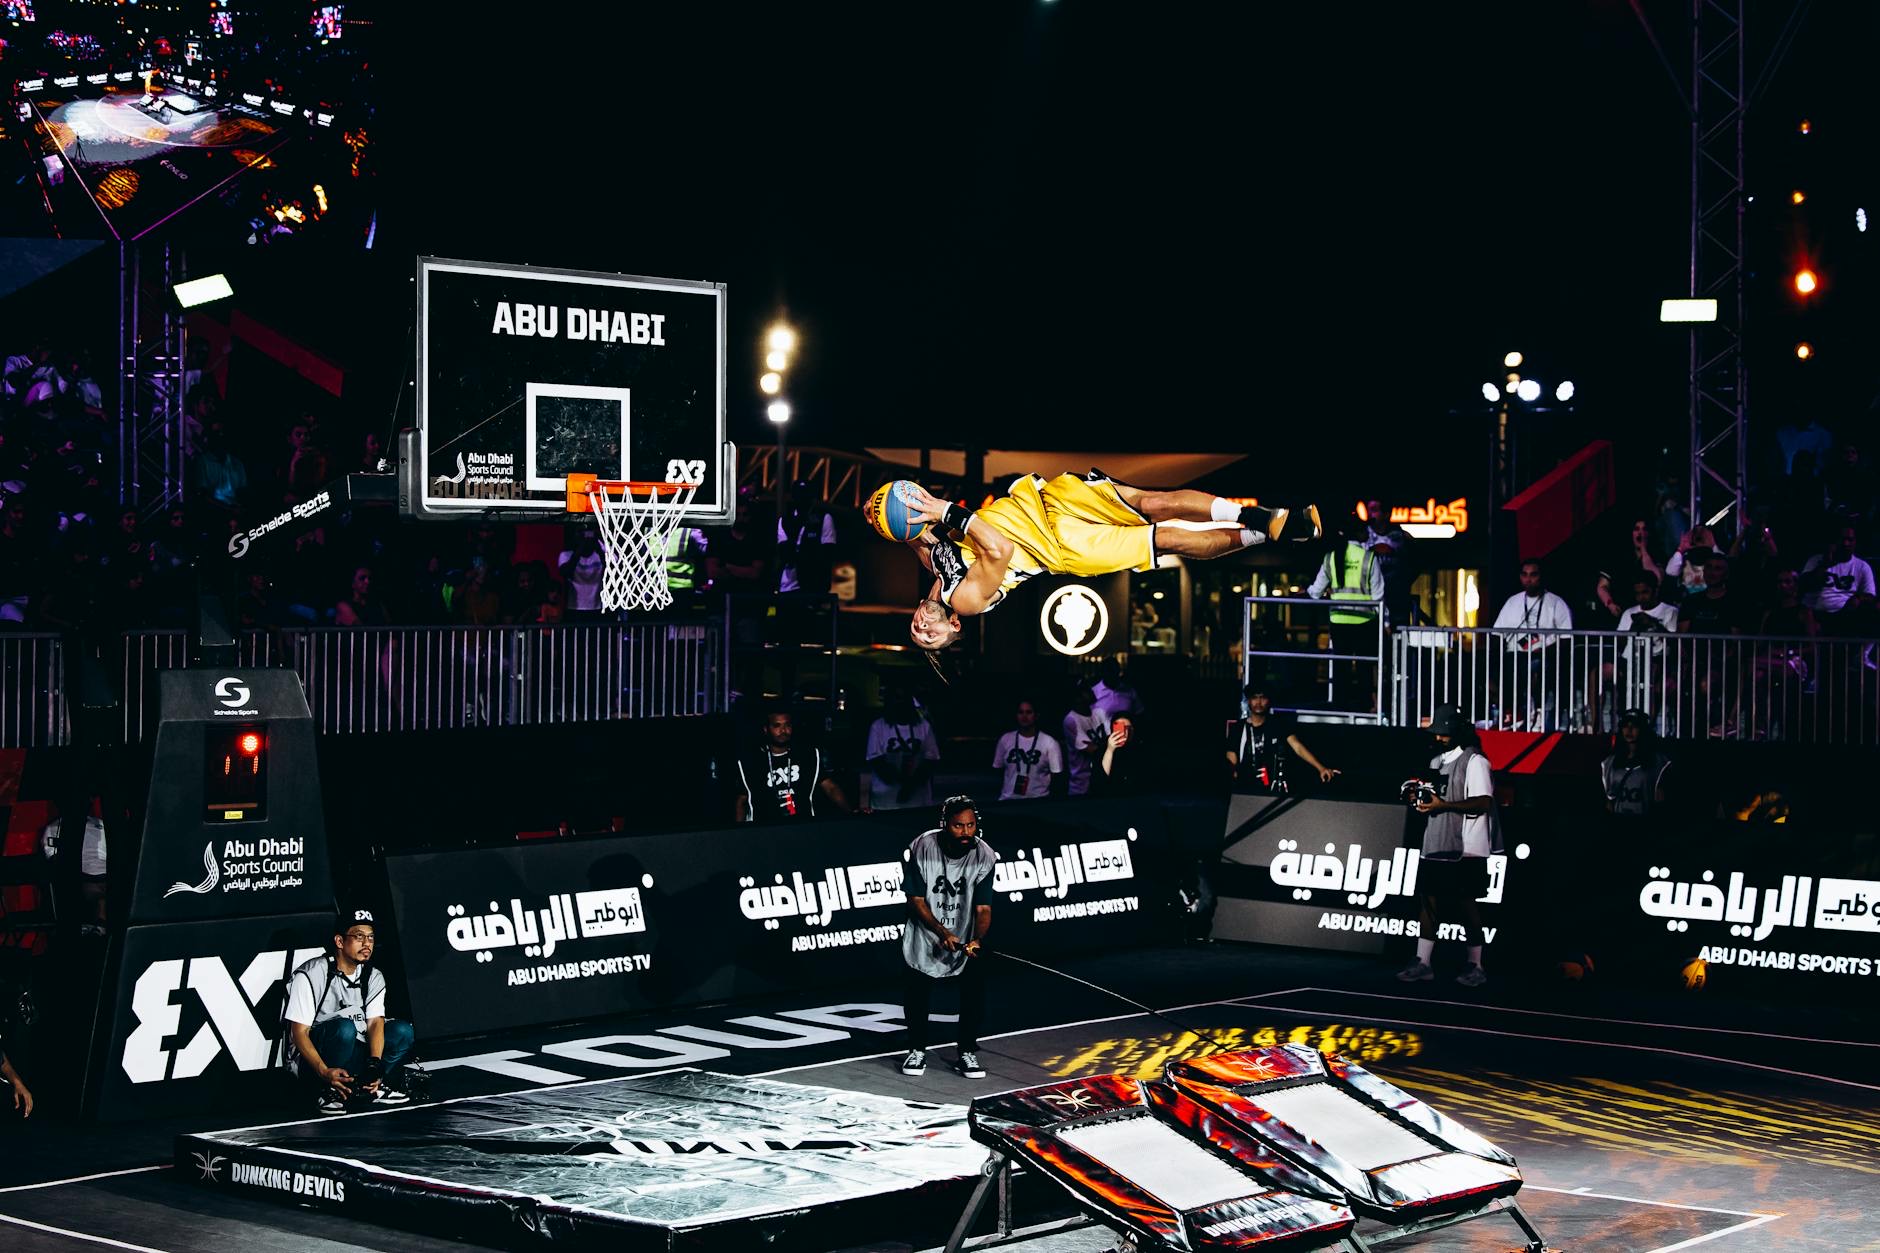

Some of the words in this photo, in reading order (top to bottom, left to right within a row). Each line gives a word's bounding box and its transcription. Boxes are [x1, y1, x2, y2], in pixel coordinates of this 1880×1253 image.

[492, 301, 559, 338] ABU
[566, 307, 666, 346] DHABI
[467, 452, 486, 464] Abu
[487, 453, 514, 465] Dhabi
[467, 464, 489, 475] Sports
[489, 465, 514, 475] Council
[248, 511, 292, 541] Schelde
[292, 491, 330, 517] Sports
[223, 840, 255, 858] Abu
[259, 837, 304, 856] Dhabi
[223, 860, 261, 878] Sports
[262, 857, 304, 873] Council
[280, 876, 303, 887] مجلس
[1270, 839, 1420, 909] الرياضية
[739, 867, 851, 930] الرياضية
[1034, 906, 1055, 922] ABU
[1055, 902, 1087, 919] DHABI
[1086, 897, 1126, 915] SPORTS
[1124, 896, 1139, 911] TV
[1640, 866, 1812, 942] الرياضية
[447, 893, 578, 963] الرياضية
[792, 934, 817, 952] ABU
[816, 930, 853, 949] DHABI
[853, 924, 899, 944] SPORTS
[1318, 912, 1353, 931] ABU
[1353, 916, 1404, 935] DHABI
[507, 966, 537, 986] ABU
[537, 961, 581, 982] DHABI
[580, 955, 634, 978] SPORTS
[632, 953, 651, 971] TV
[1698, 945, 1736, 964] ABU
[1738, 949, 1796, 970] DHABI
[1797, 953, 1872, 976] SPORTS
[231, 1162, 291, 1192] DUNKING
[292, 1172, 345, 1203] DEVILS
